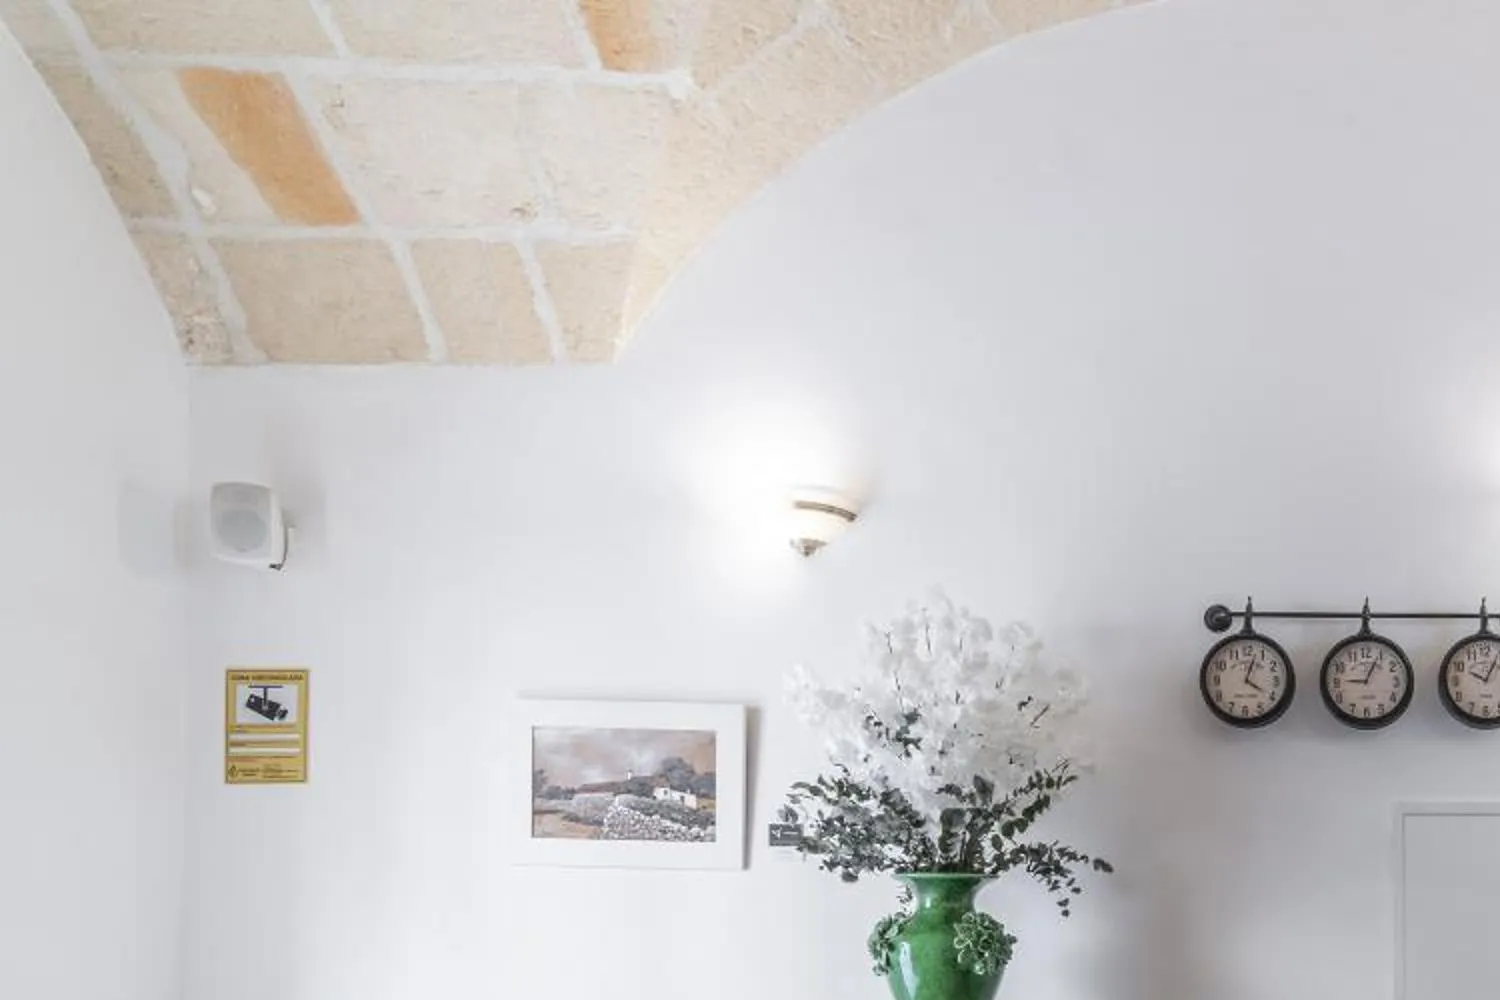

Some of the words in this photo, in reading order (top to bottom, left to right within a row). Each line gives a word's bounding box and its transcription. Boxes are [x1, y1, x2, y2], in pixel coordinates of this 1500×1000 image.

[1360, 647, 1372, 659] 12
[1466, 648, 1477, 661] 11
[1269, 660, 1277, 673] 2
[1388, 660, 1397, 673] 2
[1452, 660, 1465, 673] 10
[1228, 702, 1235, 713] 7
[1349, 703, 1357, 714] 7
[1468, 701, 1475, 713] 7
